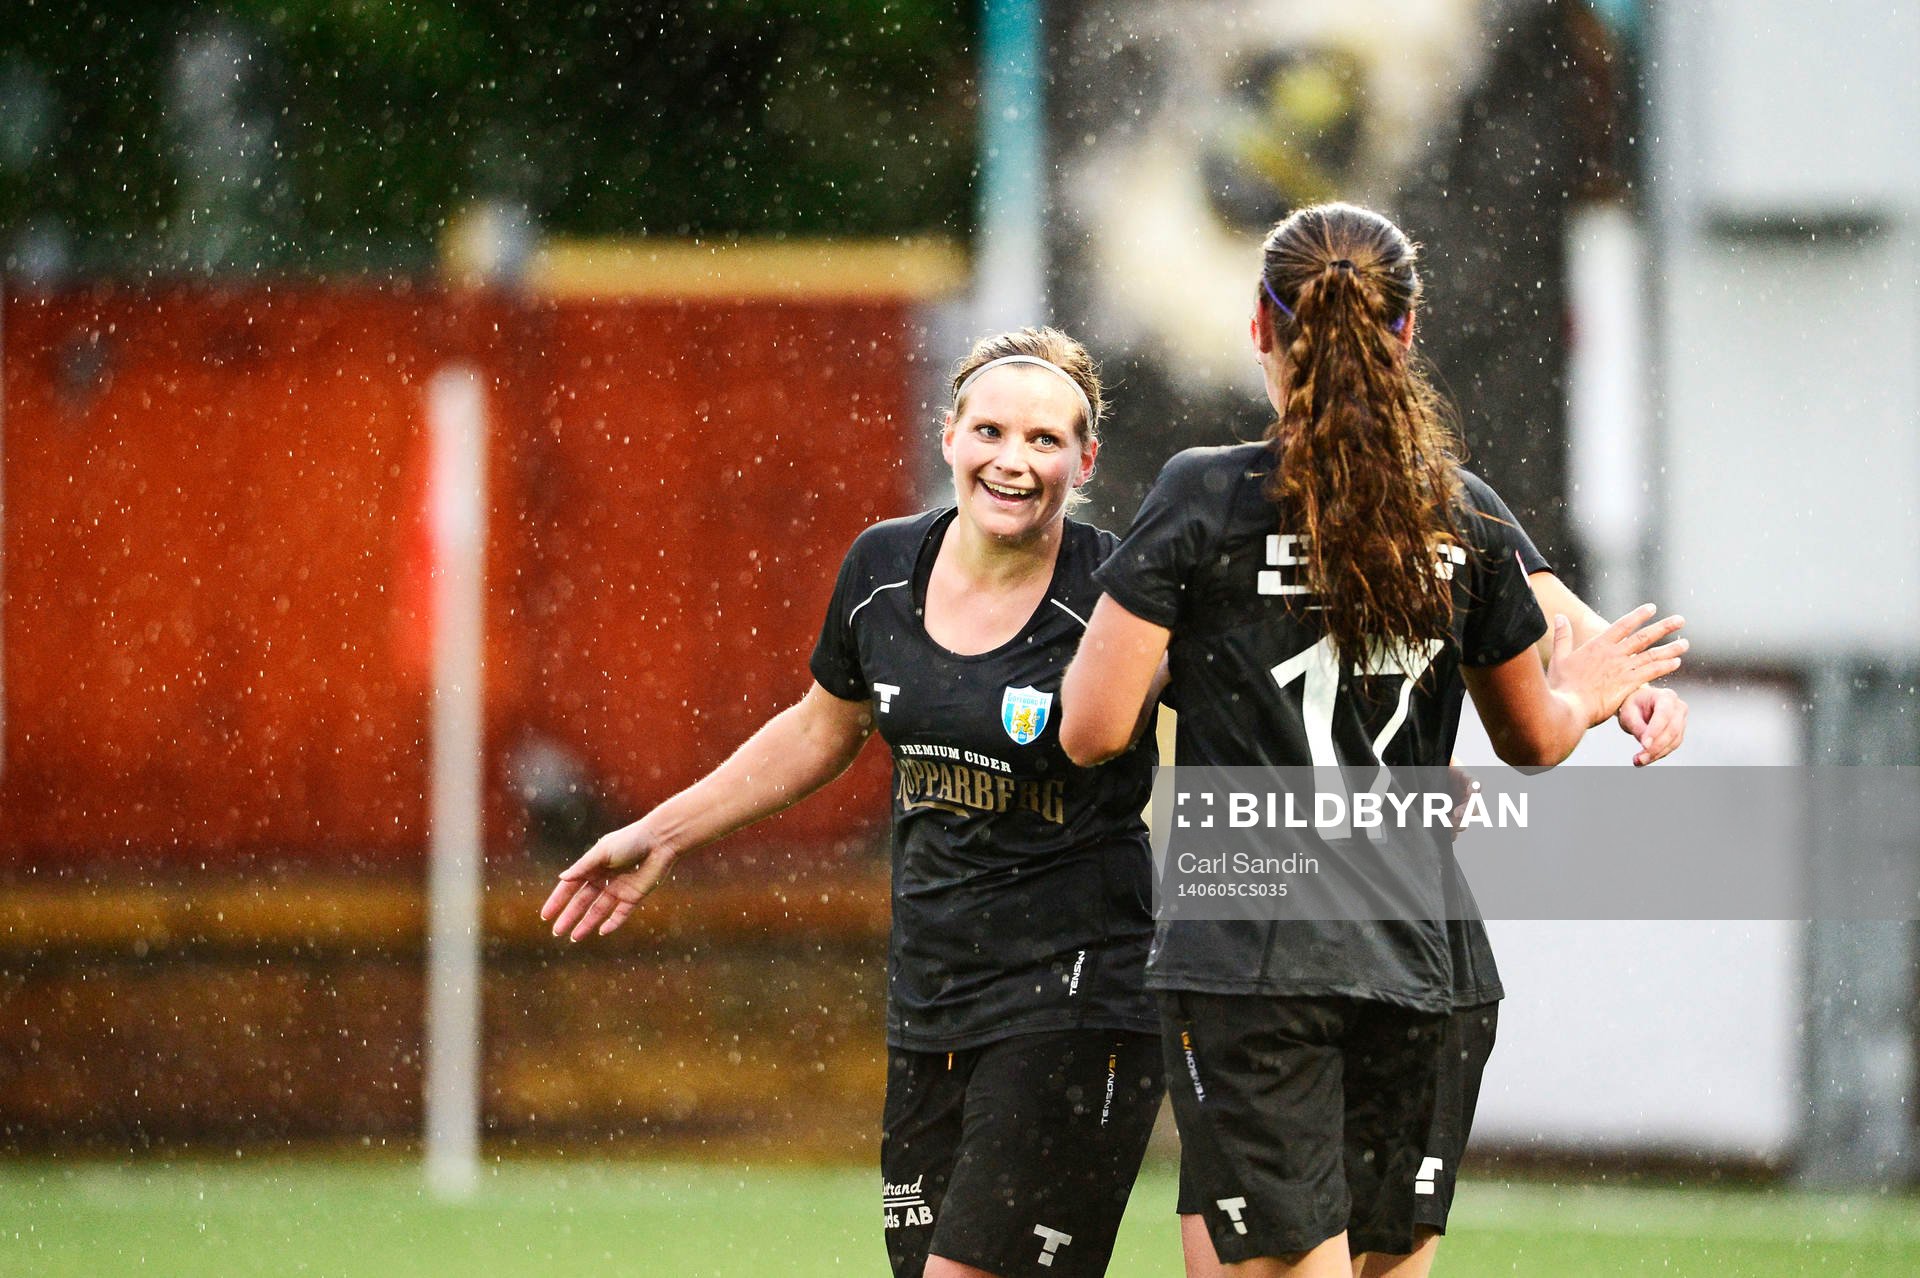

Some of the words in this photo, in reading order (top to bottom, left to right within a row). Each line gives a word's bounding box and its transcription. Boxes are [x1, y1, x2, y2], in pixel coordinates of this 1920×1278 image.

[1270, 632, 1445, 840] 17
[900, 744, 960, 760] PREMIUM
[964, 750, 1012, 773] CIDER
[905, 1206, 934, 1226] AB
